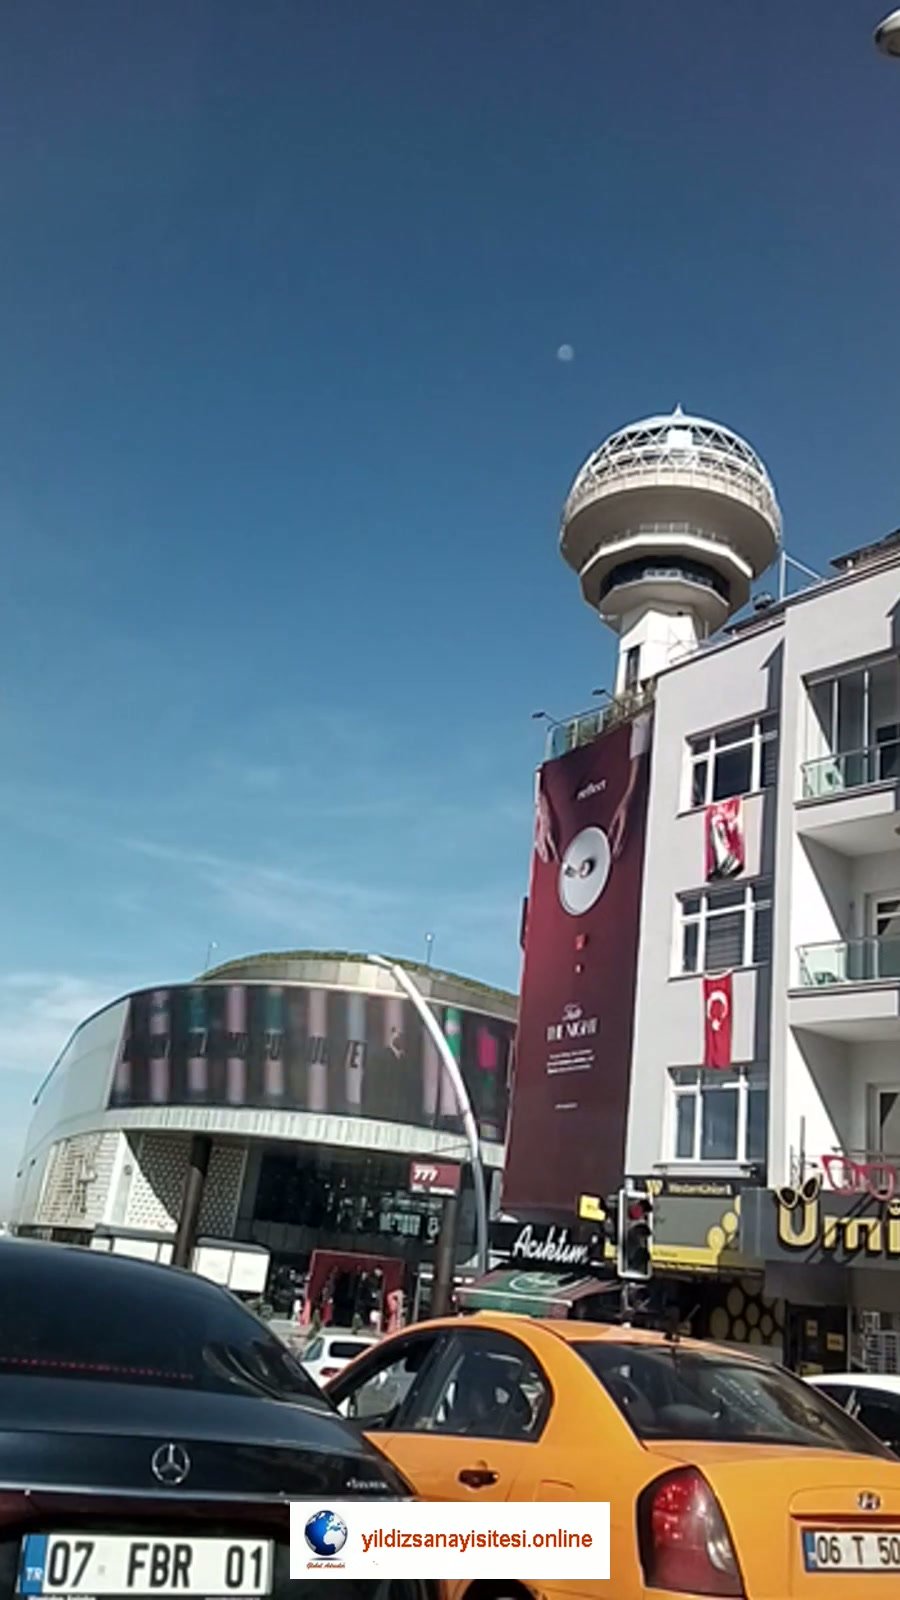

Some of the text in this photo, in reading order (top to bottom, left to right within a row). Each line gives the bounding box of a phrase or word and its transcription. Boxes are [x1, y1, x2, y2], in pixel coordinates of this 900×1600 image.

[47, 1541, 263, 1589] 07 FBR 01
[817, 1535, 900, 1566] 06 T 50
[26, 1567, 42, 1581] TR
